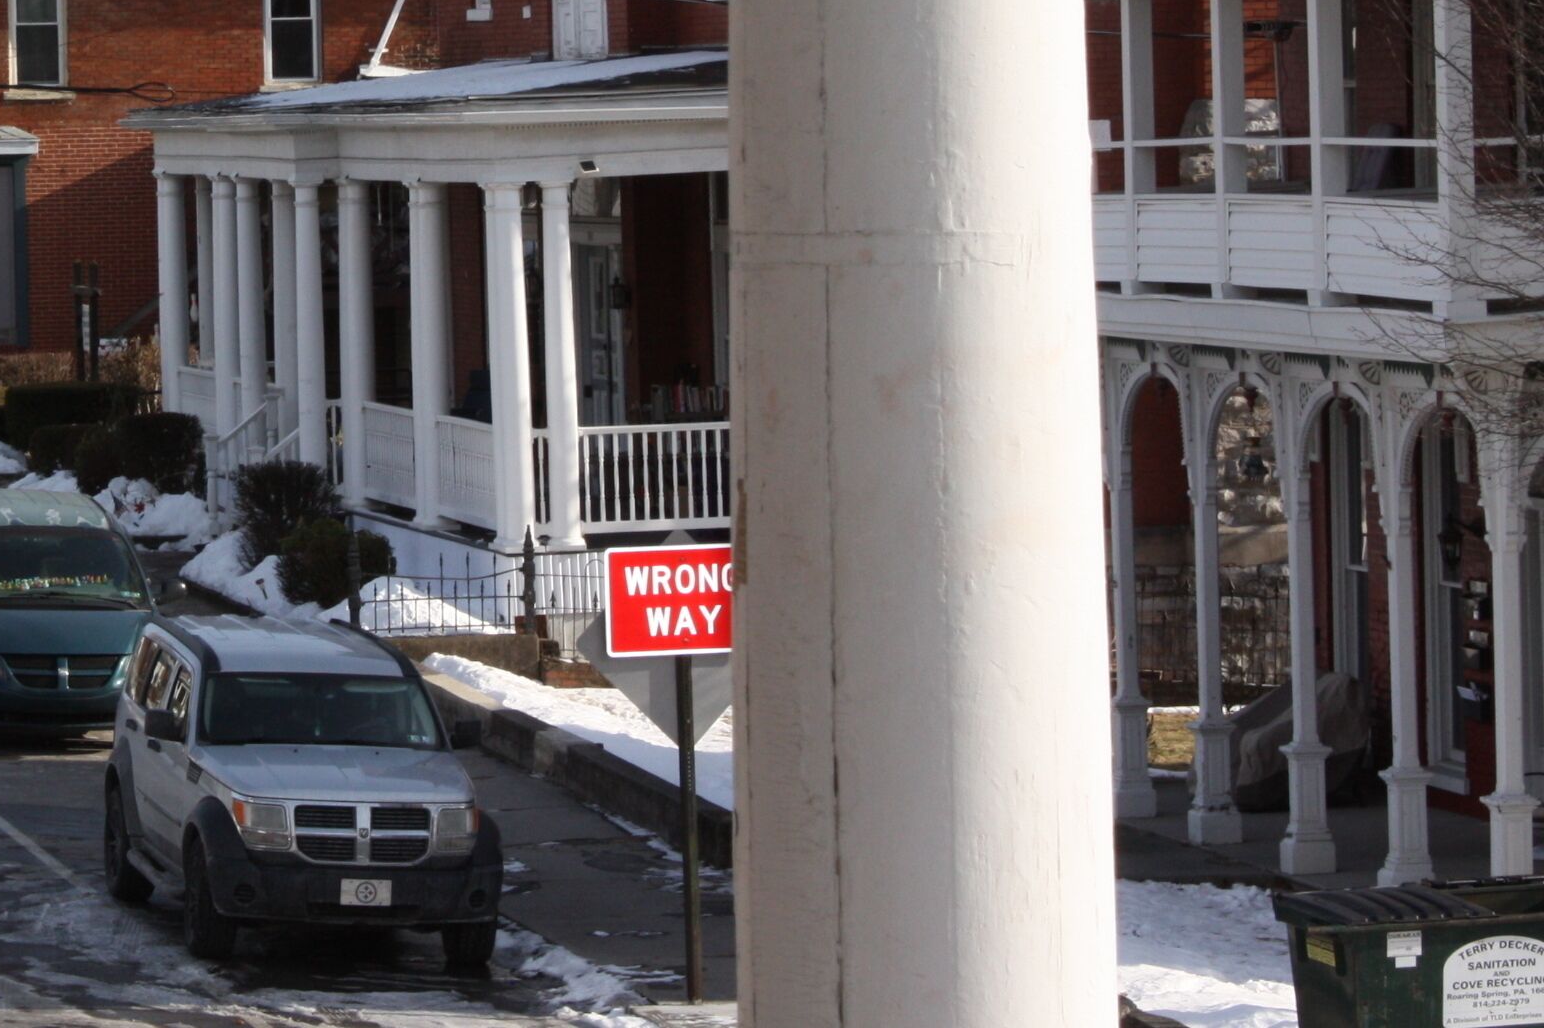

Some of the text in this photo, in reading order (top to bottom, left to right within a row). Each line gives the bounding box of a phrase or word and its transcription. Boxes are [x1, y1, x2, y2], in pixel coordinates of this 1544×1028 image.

[646, 604, 722, 637] WAY
[1458, 940, 1544, 961] TERRY DECKER
[1467, 958, 1536, 971] SANITATION
[1452, 976, 1544, 990] COVE RECYCLIN
[1446, 992, 1479, 1000] Roaring
